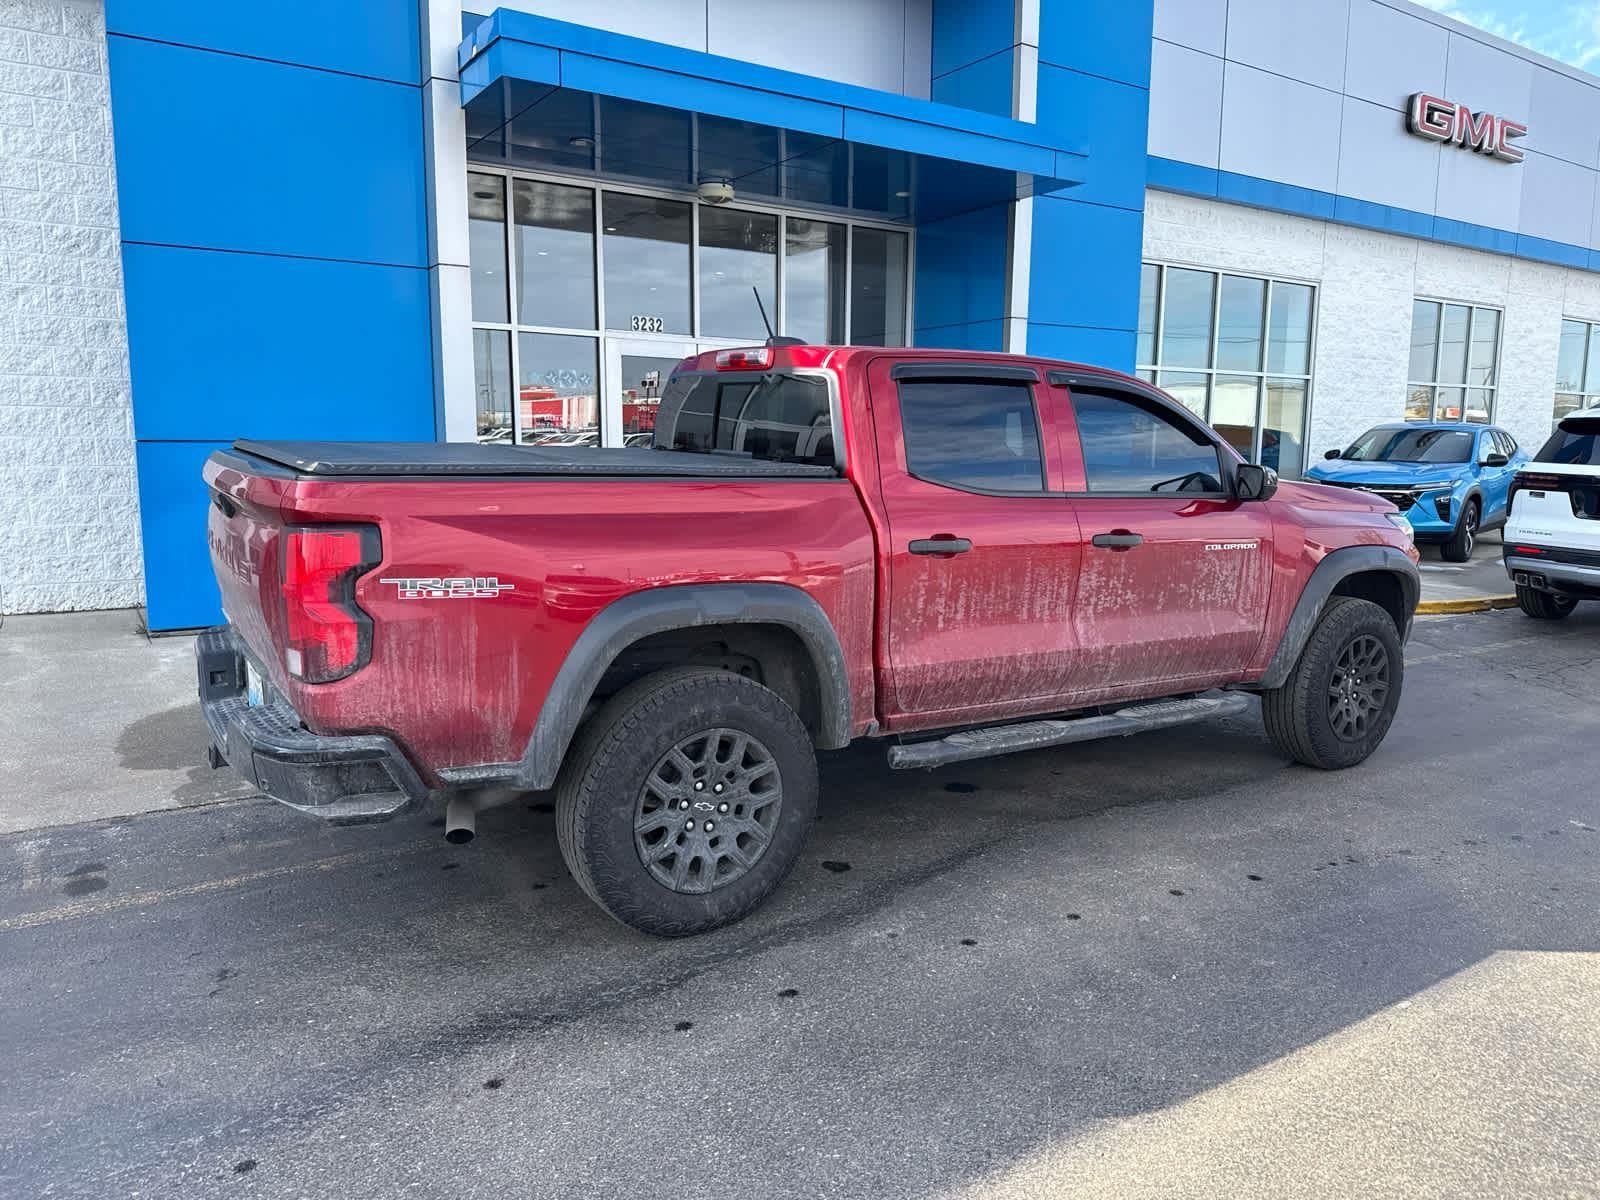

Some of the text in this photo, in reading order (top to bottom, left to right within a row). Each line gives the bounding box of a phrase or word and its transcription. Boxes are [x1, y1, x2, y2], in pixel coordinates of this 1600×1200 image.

[1407, 91, 1527, 162] GMC
[632, 316, 663, 332] 3232
[380, 577, 515, 589] TRAIL
[398, 588, 499, 599] BOSS
